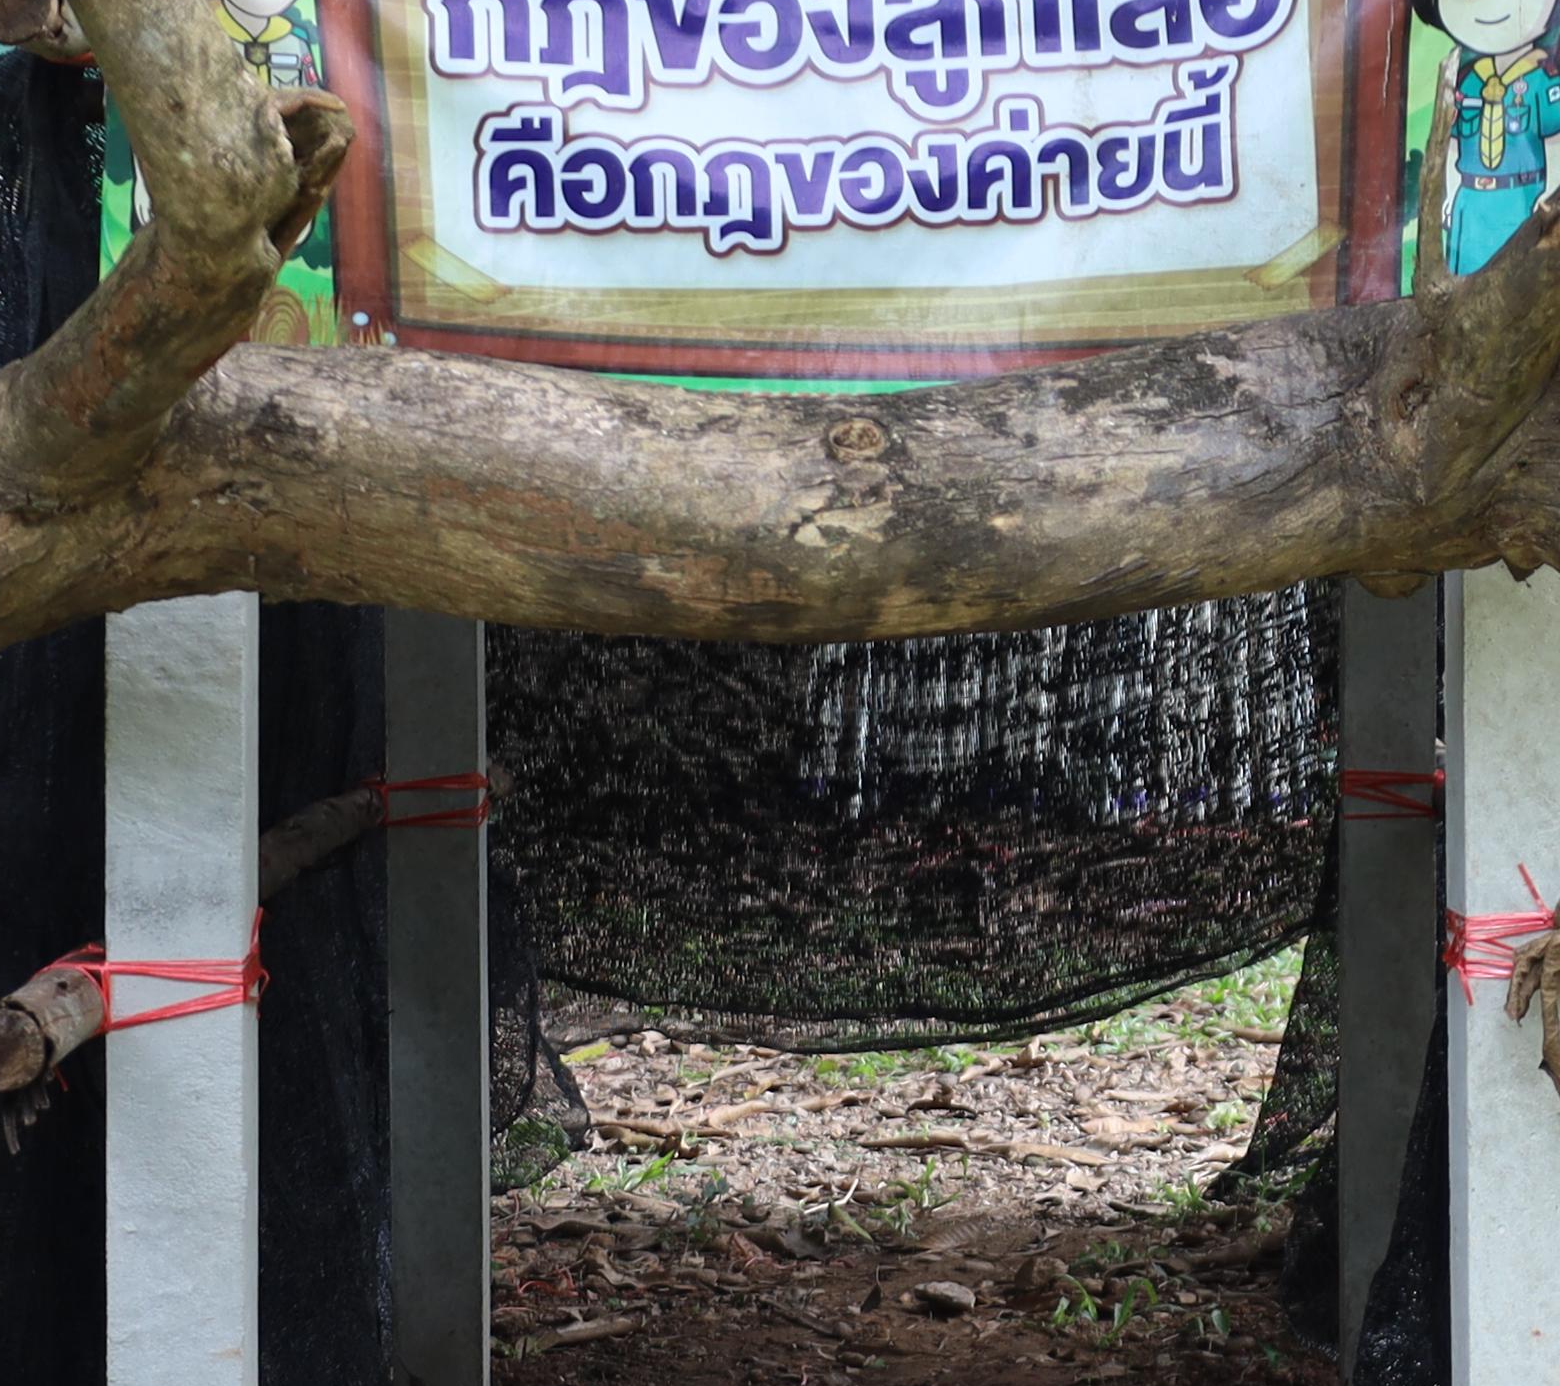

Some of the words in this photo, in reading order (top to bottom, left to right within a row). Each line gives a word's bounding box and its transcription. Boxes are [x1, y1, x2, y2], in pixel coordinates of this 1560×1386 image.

[484, 62, 1234, 244] คือกฎของค่ายนี้
